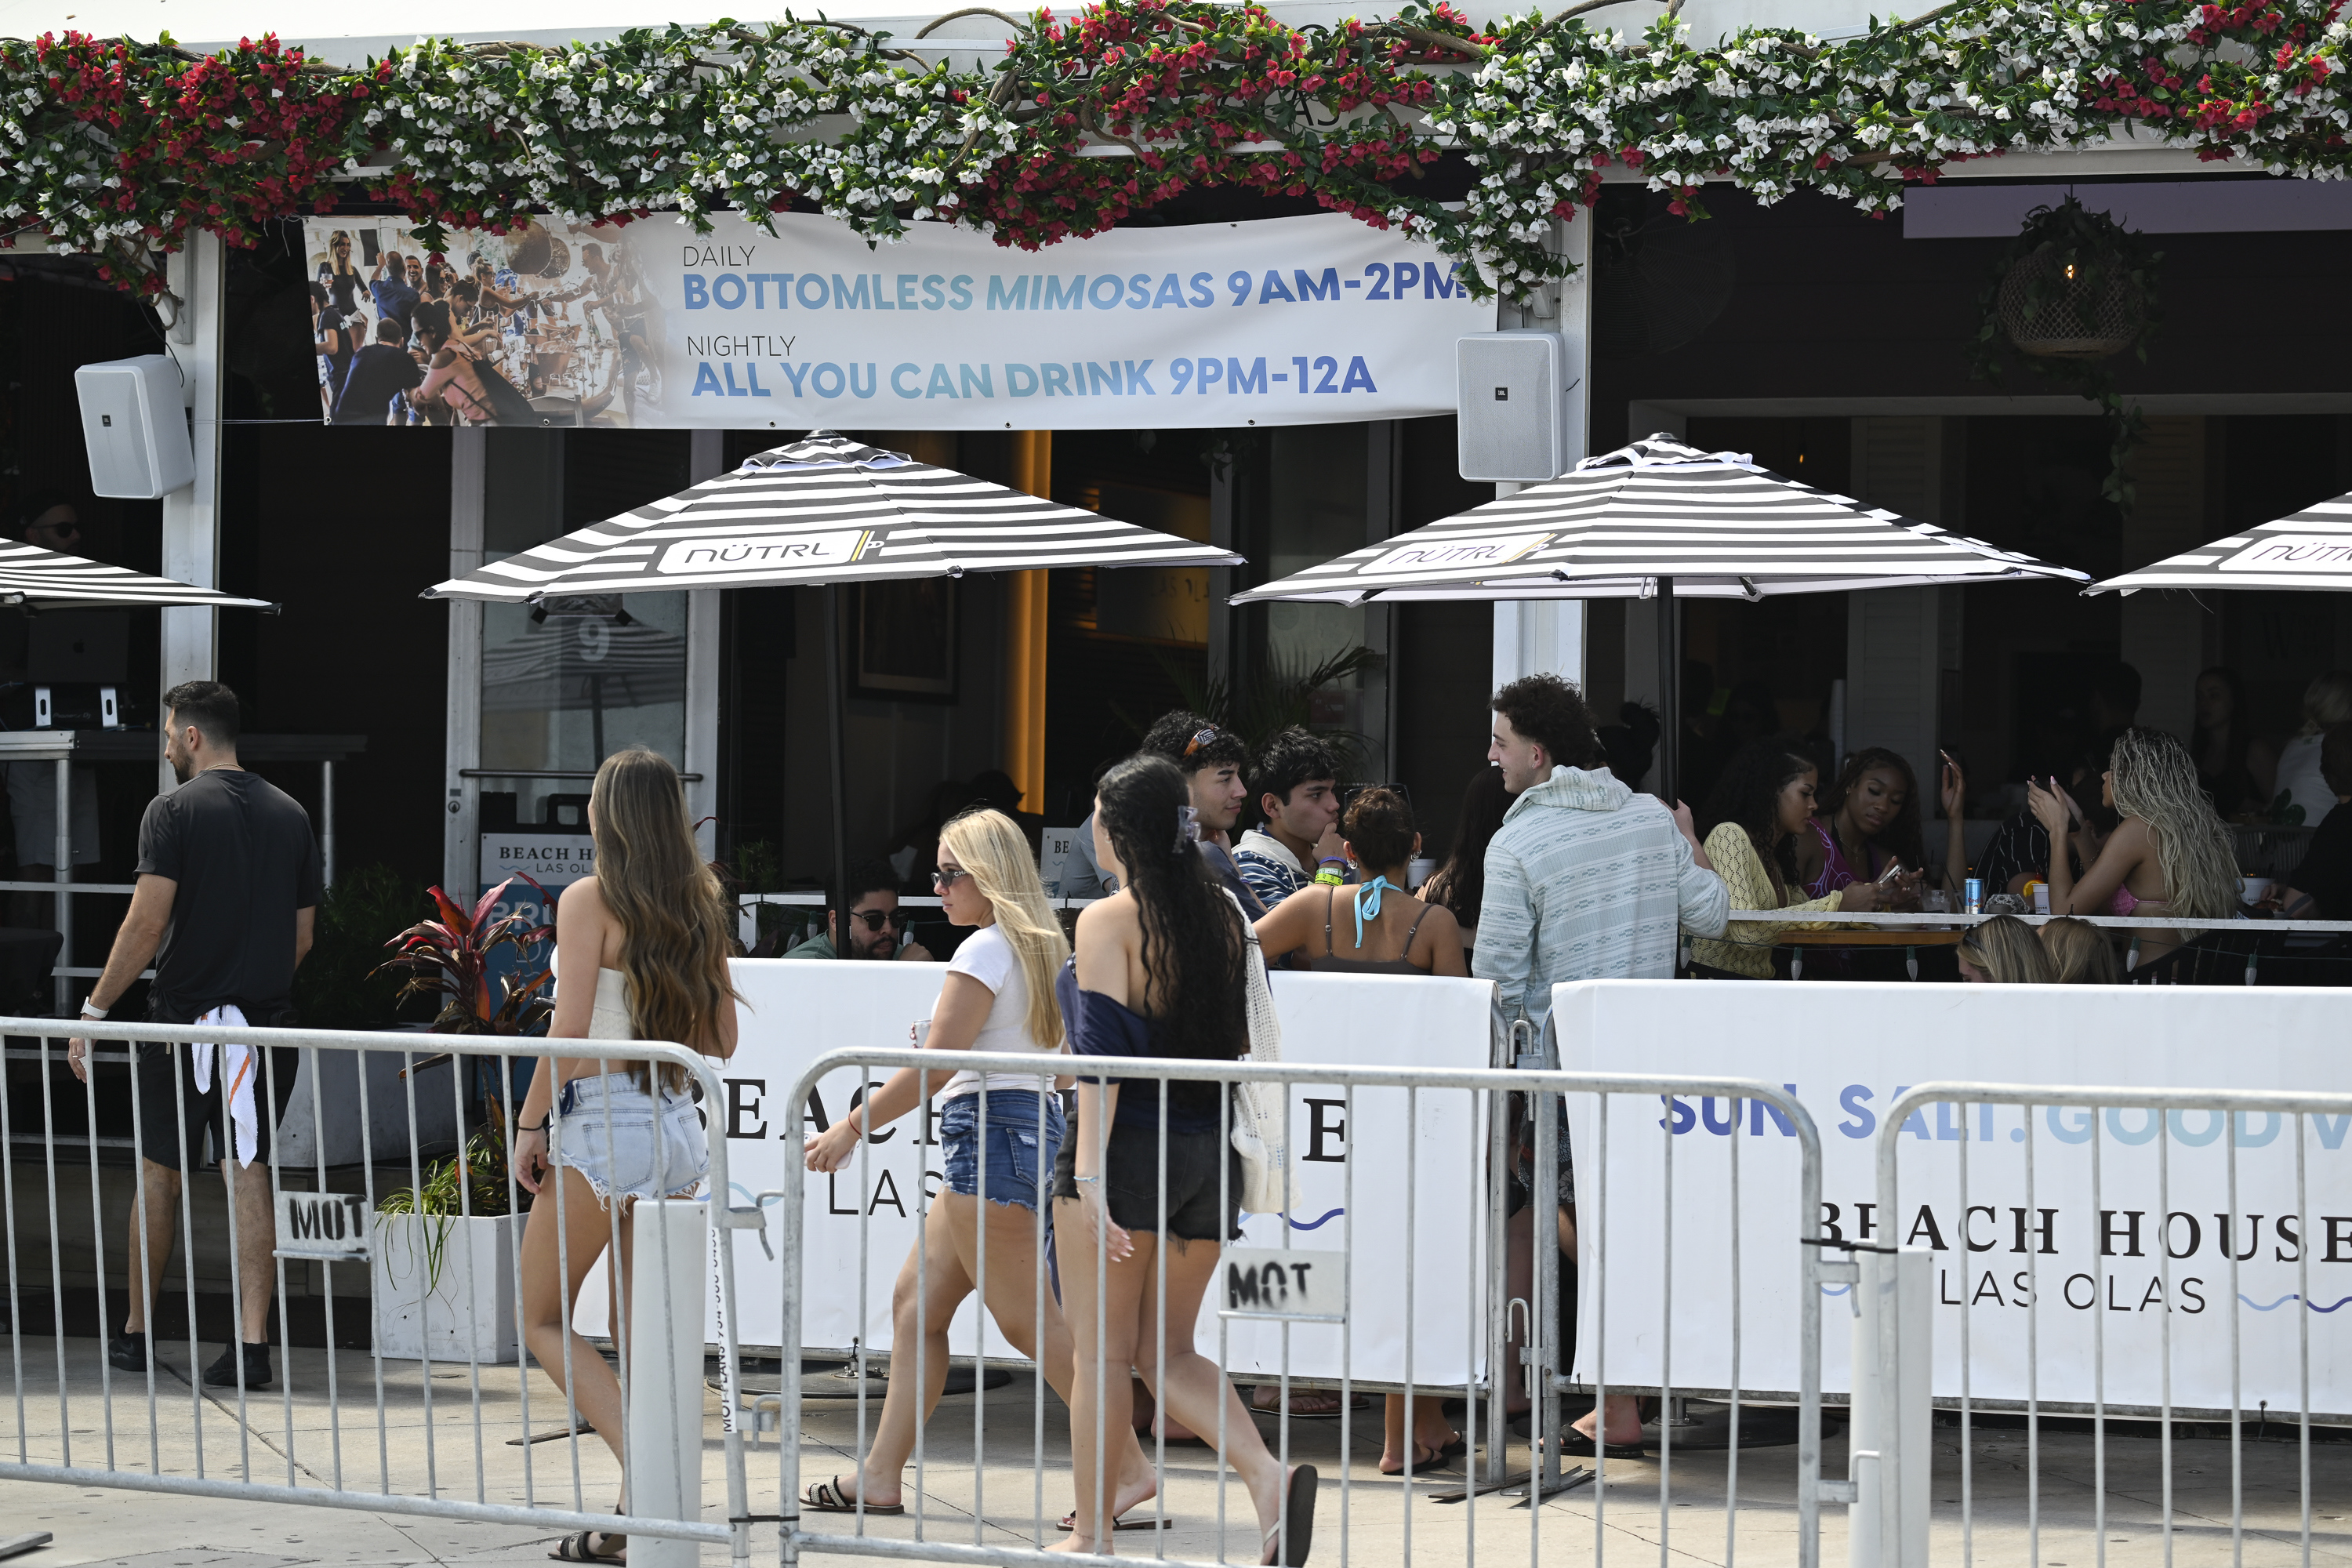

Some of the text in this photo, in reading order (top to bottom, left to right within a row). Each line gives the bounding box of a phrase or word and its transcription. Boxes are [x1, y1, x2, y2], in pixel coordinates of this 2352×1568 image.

[683, 245, 756, 267] DAILY
[683, 273, 975, 311] BOTTOMLESS
[986, 271, 1215, 310] MIMOSAS
[688, 336, 796, 357] NIGHTLY
[691, 355, 1377, 399] ALL YOU CAN DRINK 9PM-12A
[578, 616, 610, 662] 9
[499, 847, 569, 860] BEACH
[536, 863, 563, 873] LAS
[289, 1196, 367, 1240] MOT
[2100, 1210, 2352, 1262] HOUSE
[1229, 1261, 1311, 1309] MOT
[1941, 1269, 2205, 1314] LAS OLAS
